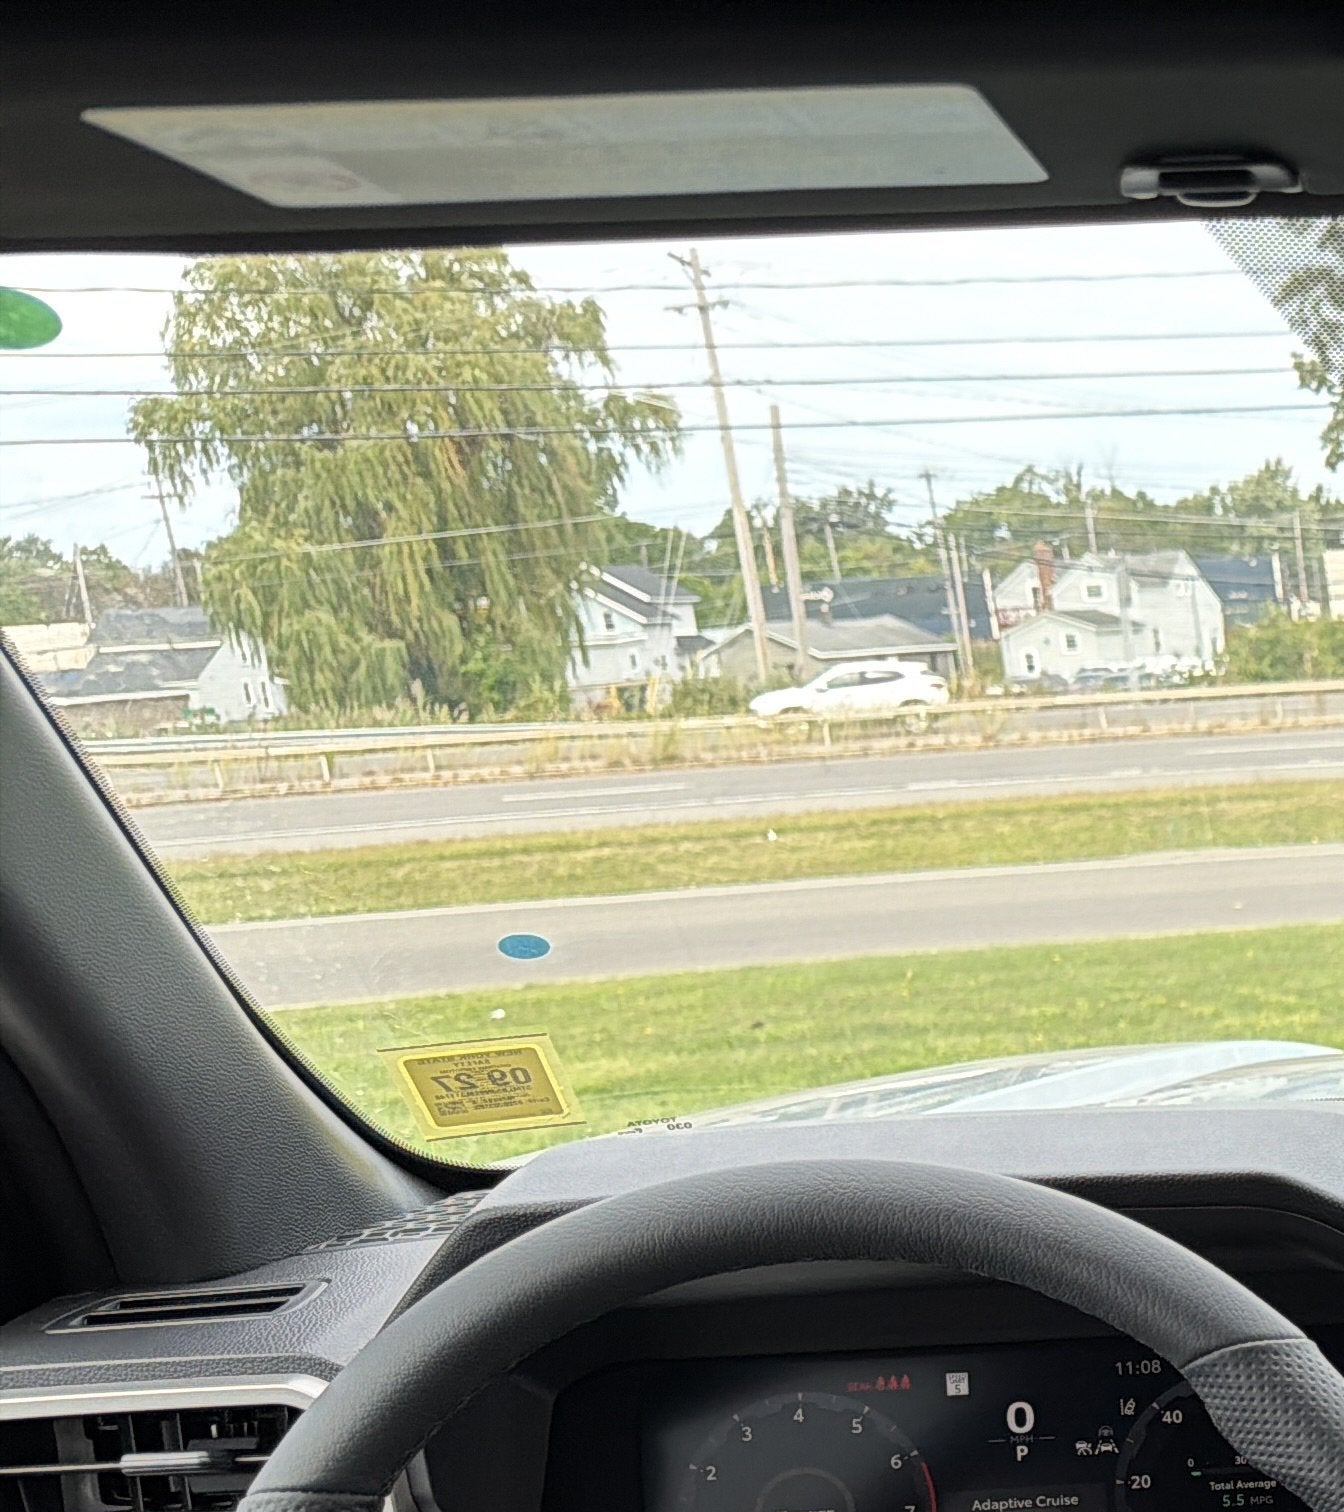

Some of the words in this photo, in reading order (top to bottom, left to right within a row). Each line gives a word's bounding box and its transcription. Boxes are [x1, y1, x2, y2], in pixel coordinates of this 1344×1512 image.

[1115, 1359, 1162, 1376] 11:08
[954, 1383, 961, 1393] 5
[793, 1408, 804, 1422] 4
[1006, 1401, 1035, 1434] 0
[1161, 1410, 1183, 1424] 40
[851, 1418, 862, 1433] 5
[741, 1426, 752, 1441] 3
[1010, 1434, 1034, 1444] MPH
[1016, 1446, 1029, 1461] P
[890, 1454, 902, 1469] 6
[1187, 1458, 1194, 1467] 0
[706, 1465, 717, 1480] 2
[1131, 1475, 1151, 1489] 20
[1209, 1480, 1234, 1491] Total
[1236, 1479, 1277, 1490] Average
[971, 1496, 1033, 1512] Adaptive
[1036, 1494, 1079, 1508] Cruise
[1222, 1494, 1245, 1507] 5.5
[1250, 1495, 1274, 1505] MPG
